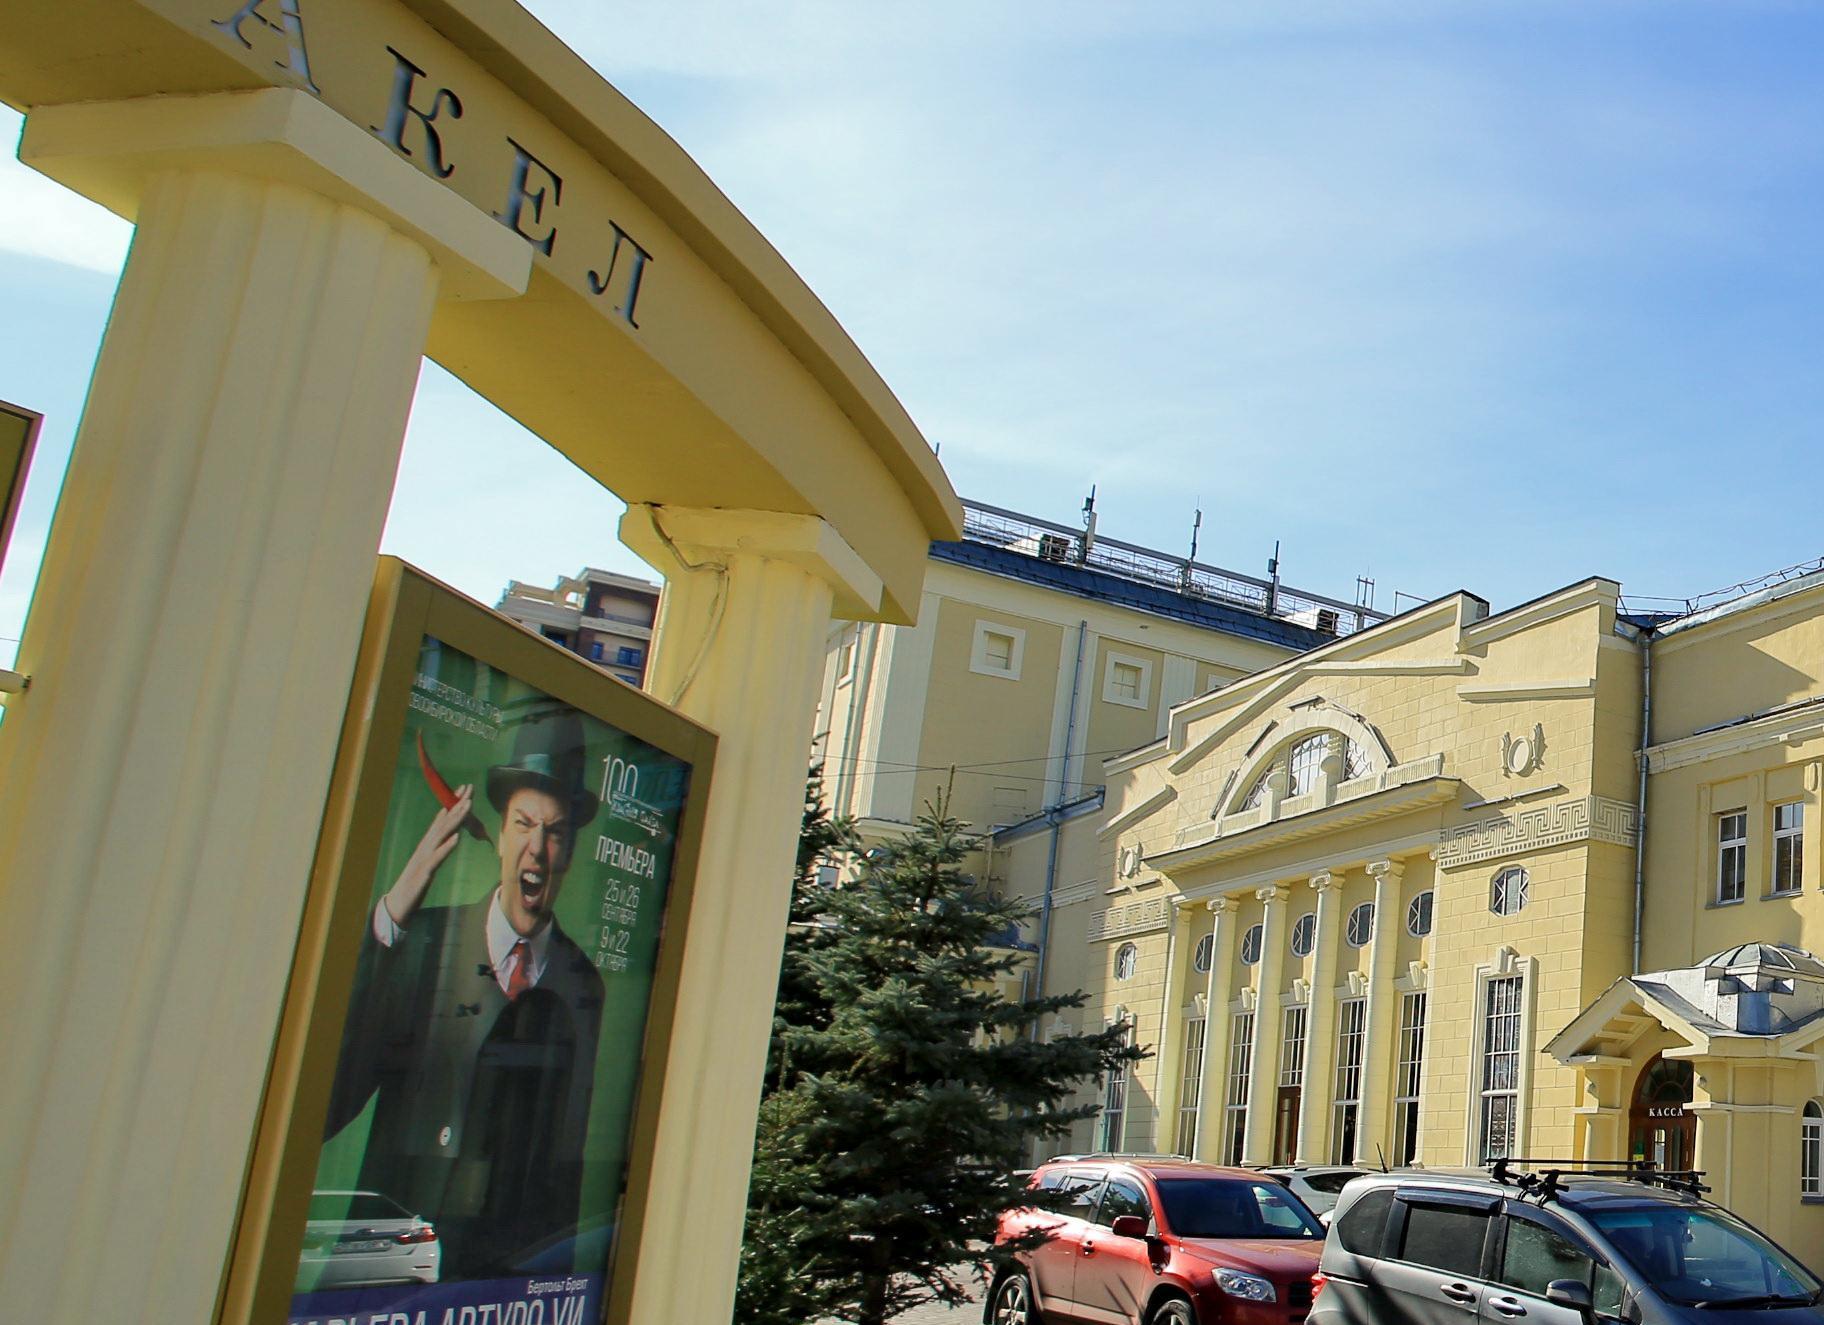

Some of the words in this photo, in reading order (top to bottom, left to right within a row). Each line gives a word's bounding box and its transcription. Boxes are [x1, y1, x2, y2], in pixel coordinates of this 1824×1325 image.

[600, 754, 638, 806] 100
[595, 834, 656, 879] ПРЕМЬЕРА
[605, 878, 621, 902] 25
[626, 884, 640, 909] 26
[600, 926, 609, 949] 9
[615, 930, 631, 954] 22
[1649, 1107, 1684, 1117] КАССА
[527, 1280, 565, 1295] Бертольт
[565, 1277, 588, 1293] Брехт
